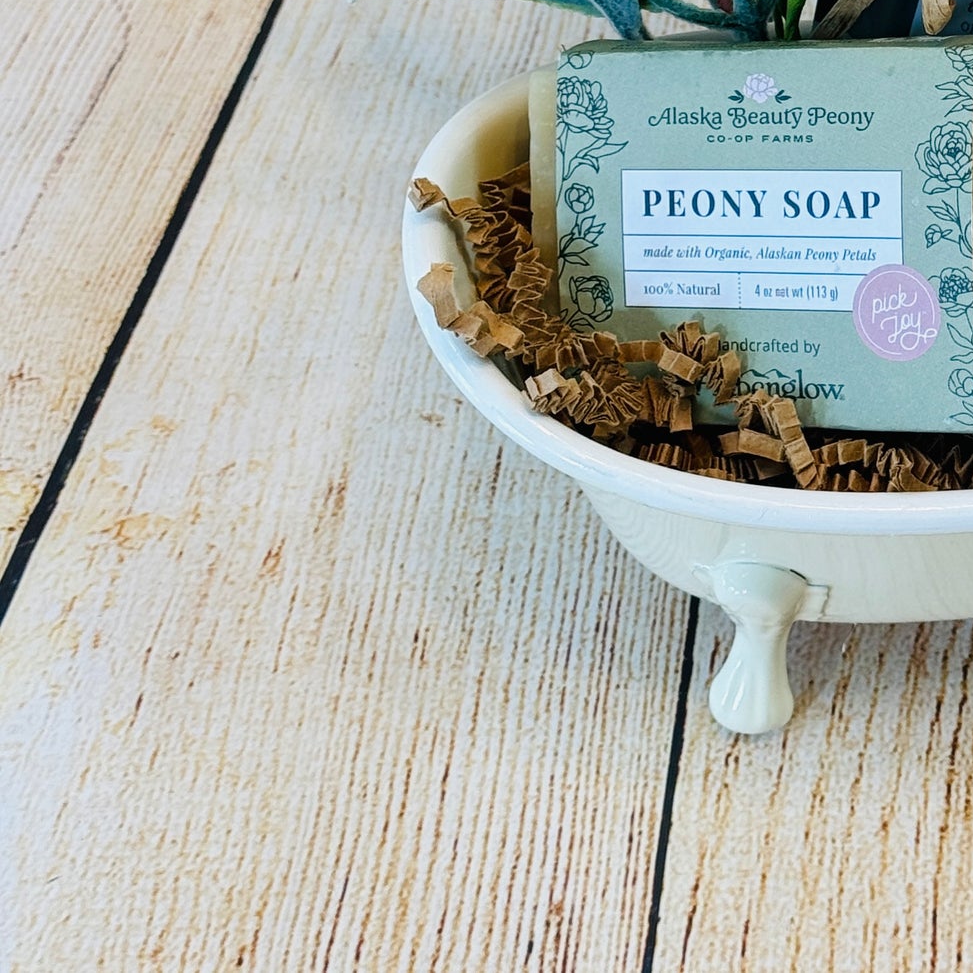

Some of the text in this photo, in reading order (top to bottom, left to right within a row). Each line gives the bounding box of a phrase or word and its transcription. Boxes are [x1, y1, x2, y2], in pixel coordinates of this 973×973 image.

[648, 106, 875, 132] Alaska Beauty Peony
[706, 134, 814, 144] CO-OP FARMS
[642, 189, 881, 220] PEONY SOAP
[643, 244, 877, 264] made with Organic, Alaskan Peony Petals
[643, 283, 721, 296] 100% Natural
[754, 284, 761, 297] 4
[763, 287, 772, 298] oz
[791, 286, 803, 298] wt
[806, 284, 828, 301] (113
[830, 285, 839, 302] g)
[872, 283, 917, 323] pick
[803, 338, 821, 357] by
